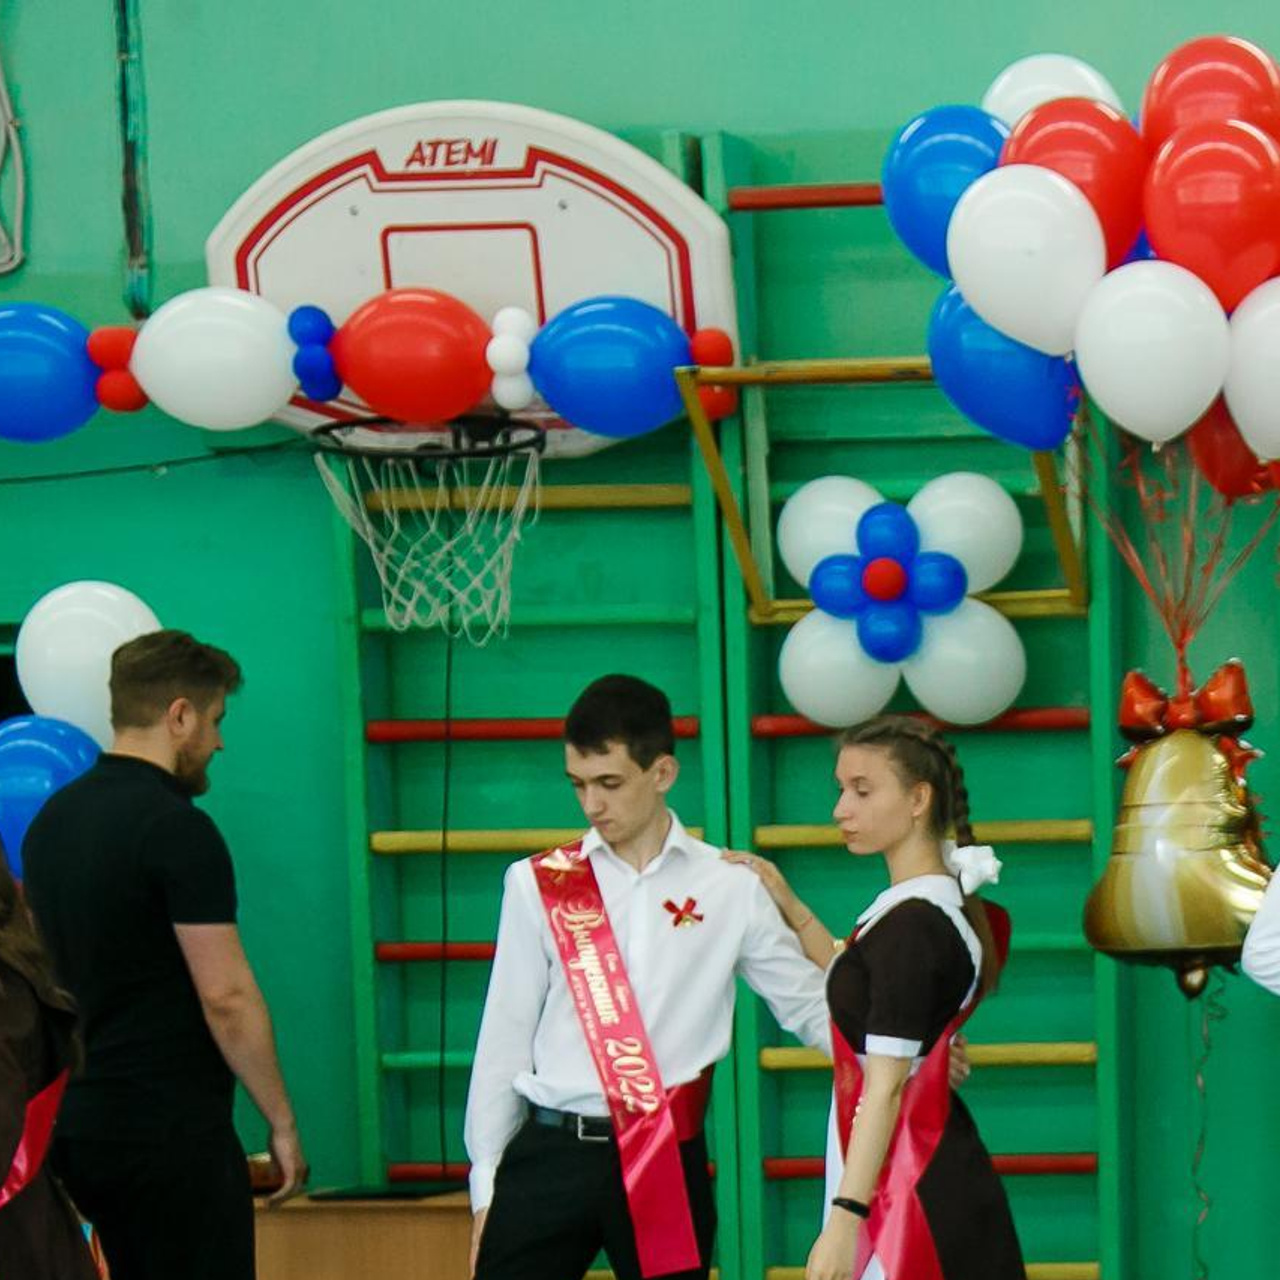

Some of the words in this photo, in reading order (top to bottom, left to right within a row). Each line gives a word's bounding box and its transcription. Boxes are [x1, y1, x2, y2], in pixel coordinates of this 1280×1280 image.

[404, 138, 498, 168] ATEMI
[557, 898, 621, 1026] Выпускник
[604, 1036, 660, 1114] 2022
